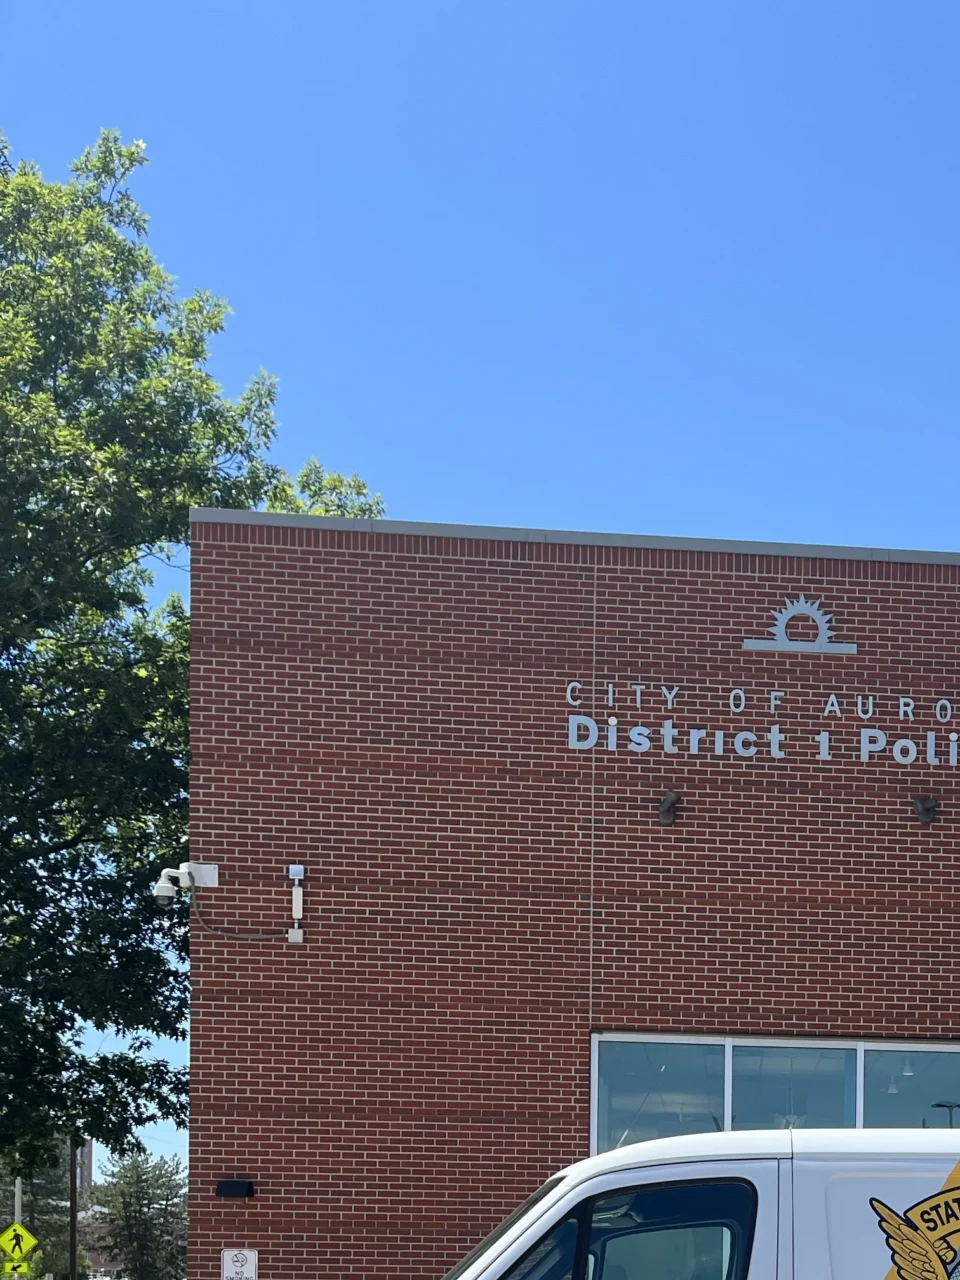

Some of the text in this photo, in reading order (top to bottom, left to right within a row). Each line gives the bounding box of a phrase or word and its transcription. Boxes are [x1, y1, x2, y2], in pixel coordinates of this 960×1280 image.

[566, 681, 680, 710] CITY
[729, 689, 785, 714] OF
[568, 715, 786, 759] District
[815, 731, 832, 761] 1
